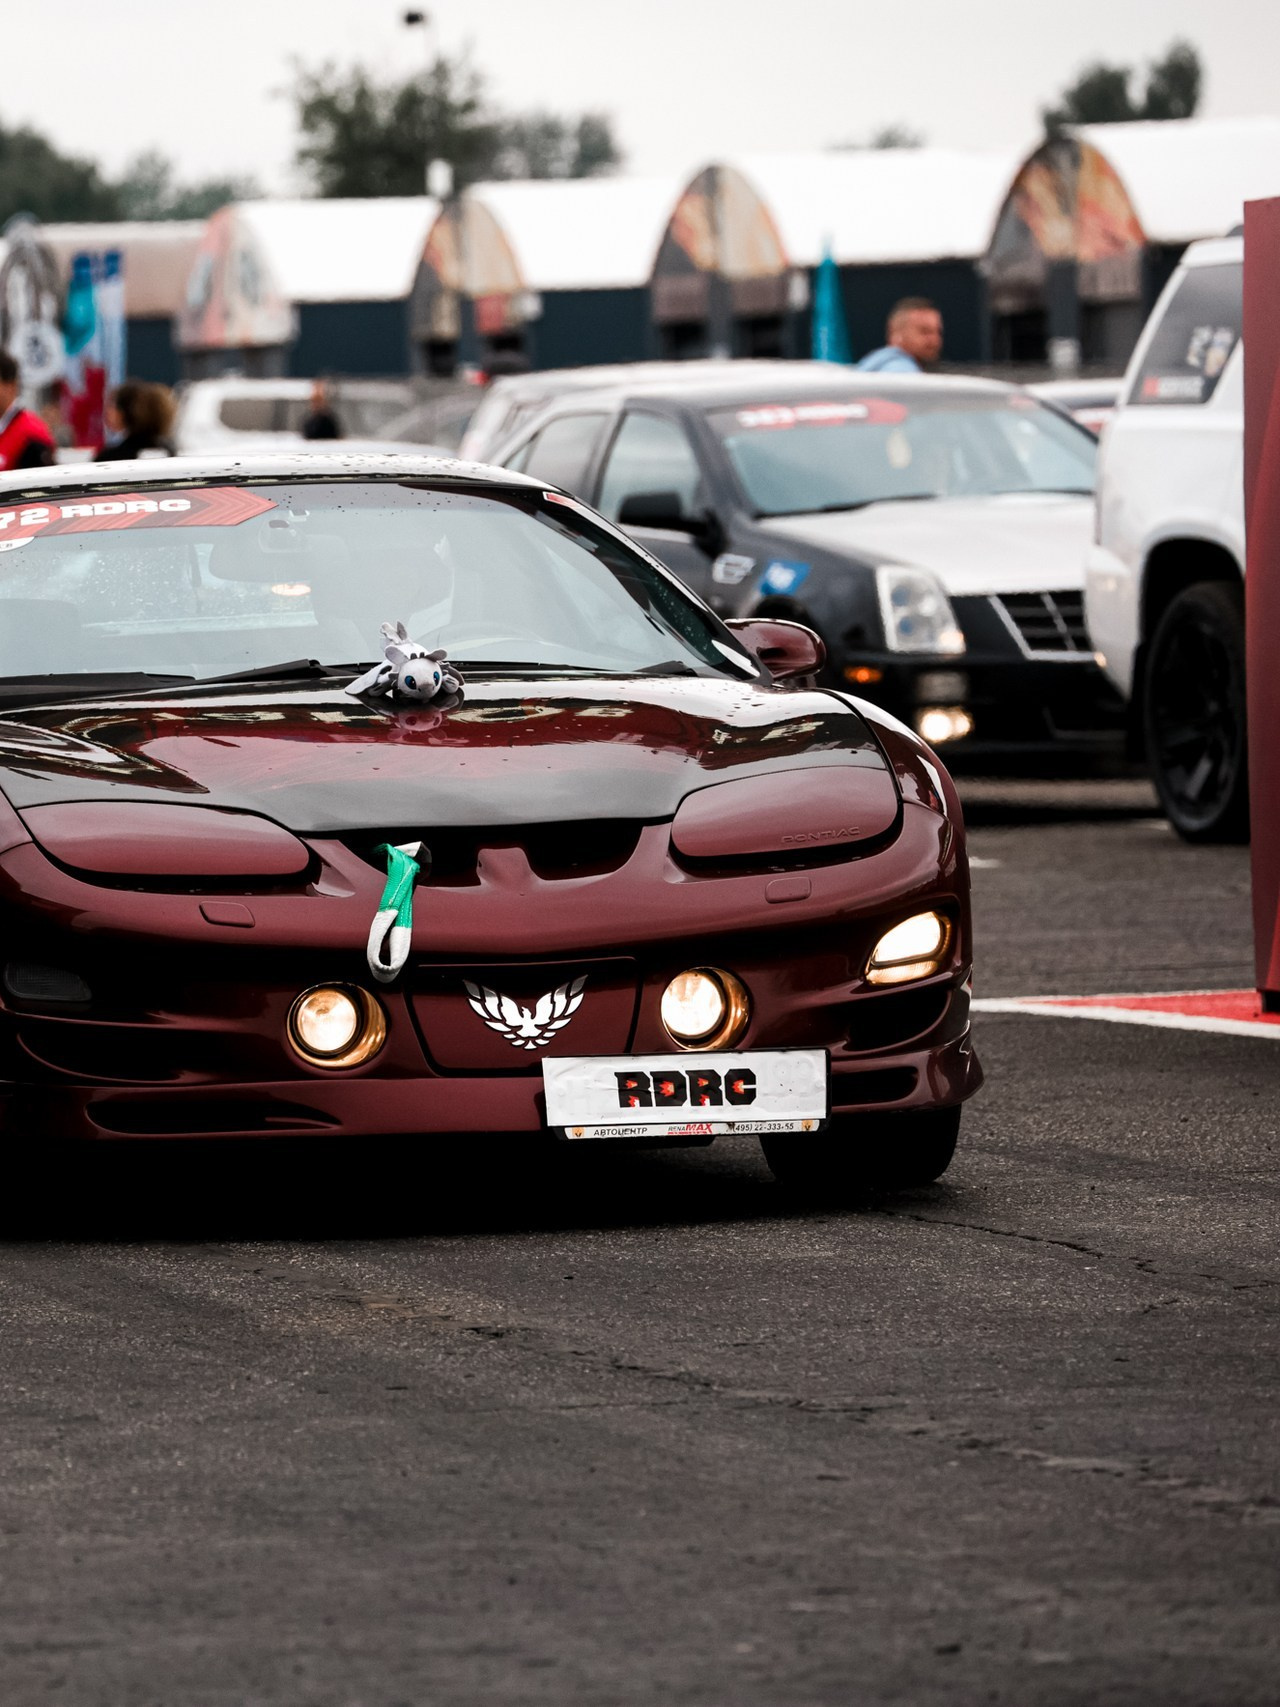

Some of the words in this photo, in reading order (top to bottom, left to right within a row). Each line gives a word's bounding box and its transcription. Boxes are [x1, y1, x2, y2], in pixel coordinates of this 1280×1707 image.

[60, 499, 191, 518] RDRC
[781, 826, 860, 843] PONTIAC
[614, 1068, 756, 1107] RDRC
[593, 1127, 648, 1137] АВТОЦЕНТР
